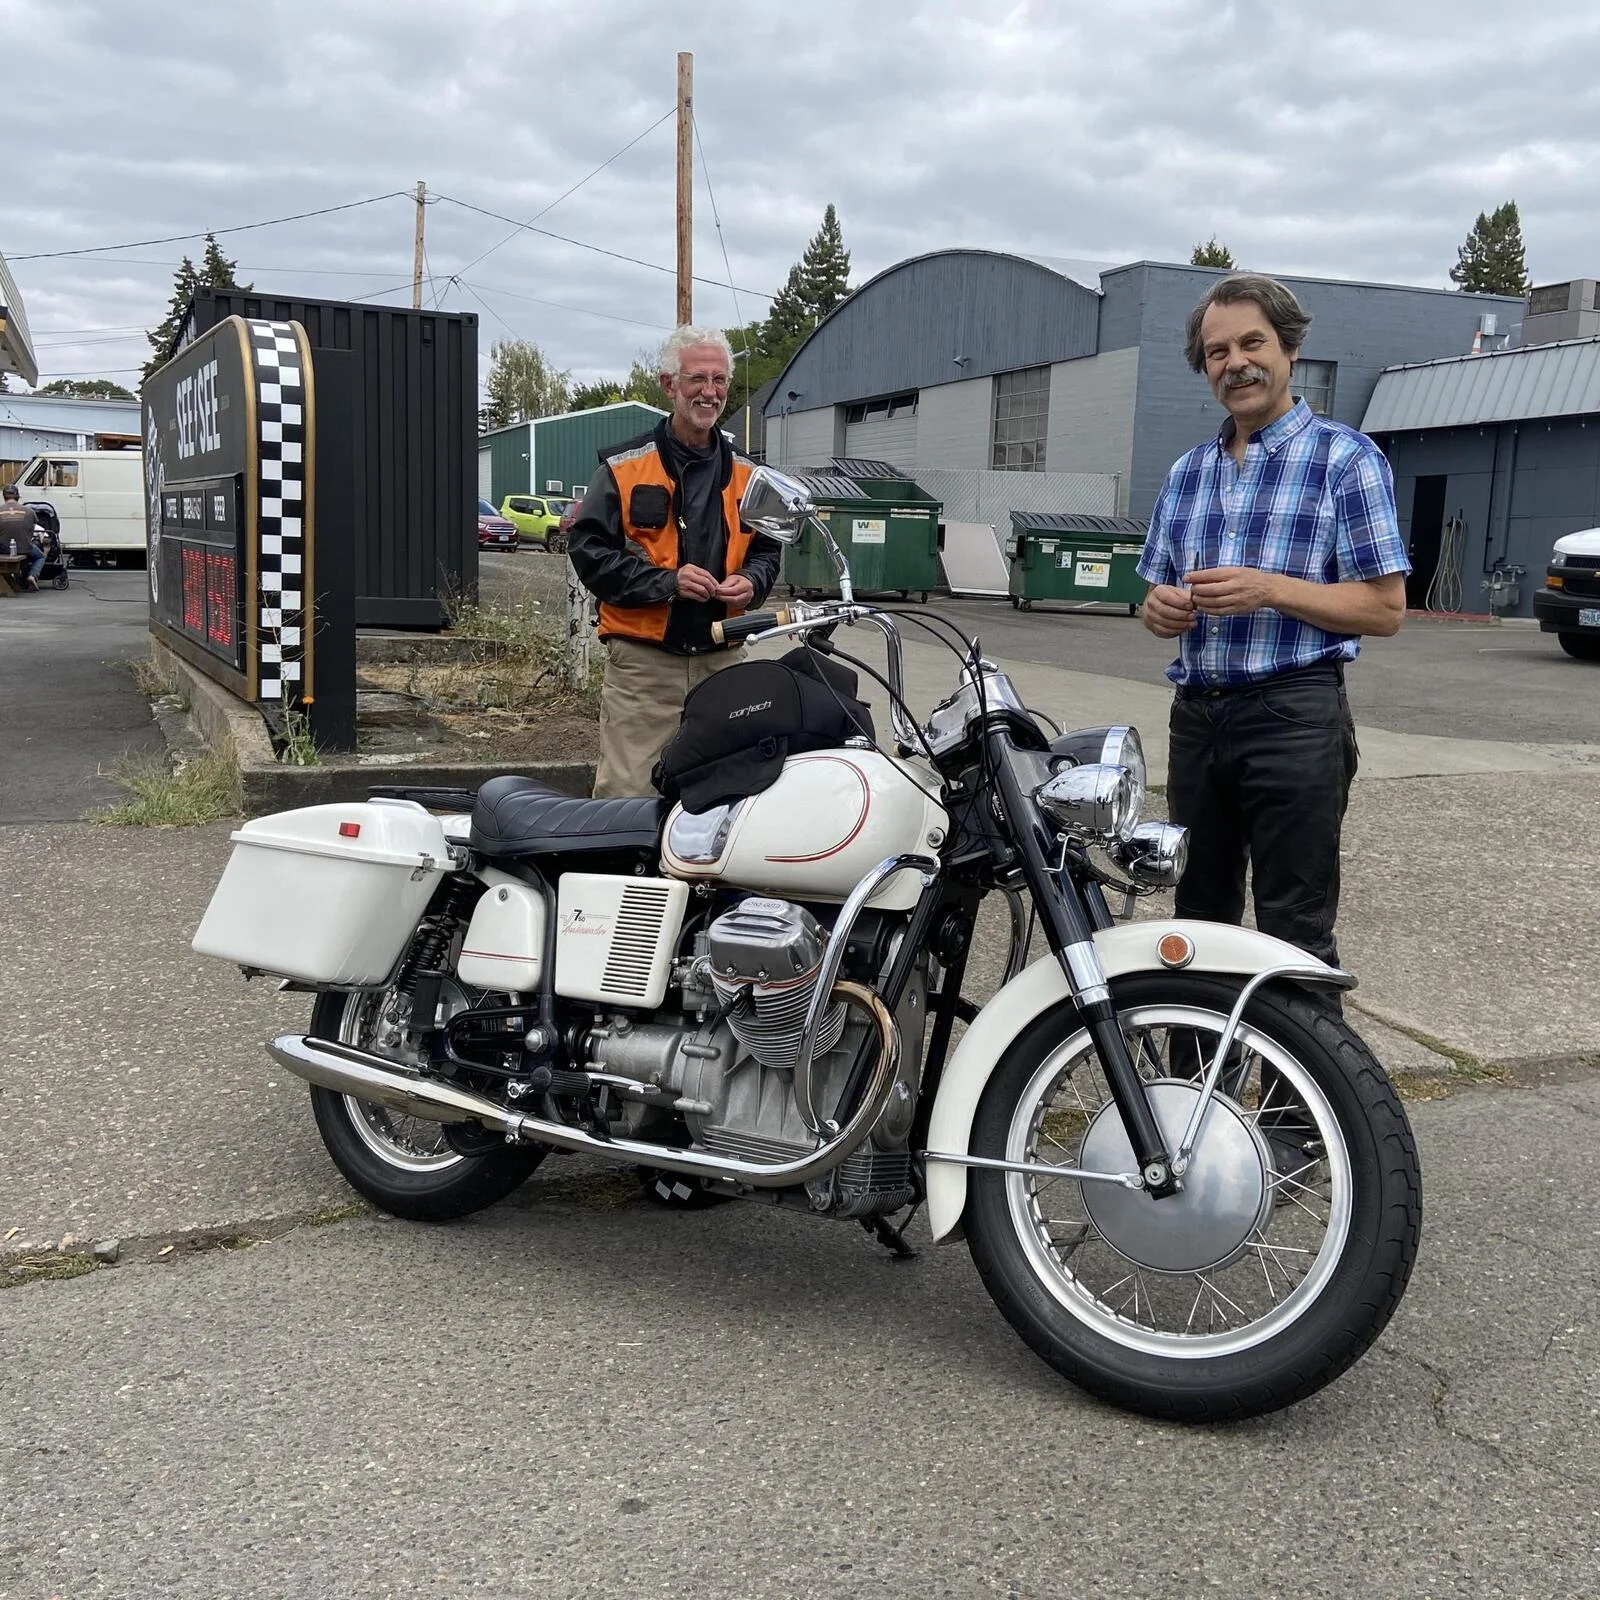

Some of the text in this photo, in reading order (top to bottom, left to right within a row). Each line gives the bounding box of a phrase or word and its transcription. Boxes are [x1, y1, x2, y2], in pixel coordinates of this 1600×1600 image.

[197, 359, 221, 454] SEE
[857, 521, 881, 529] WM
[1081, 564, 1104, 572] WM
